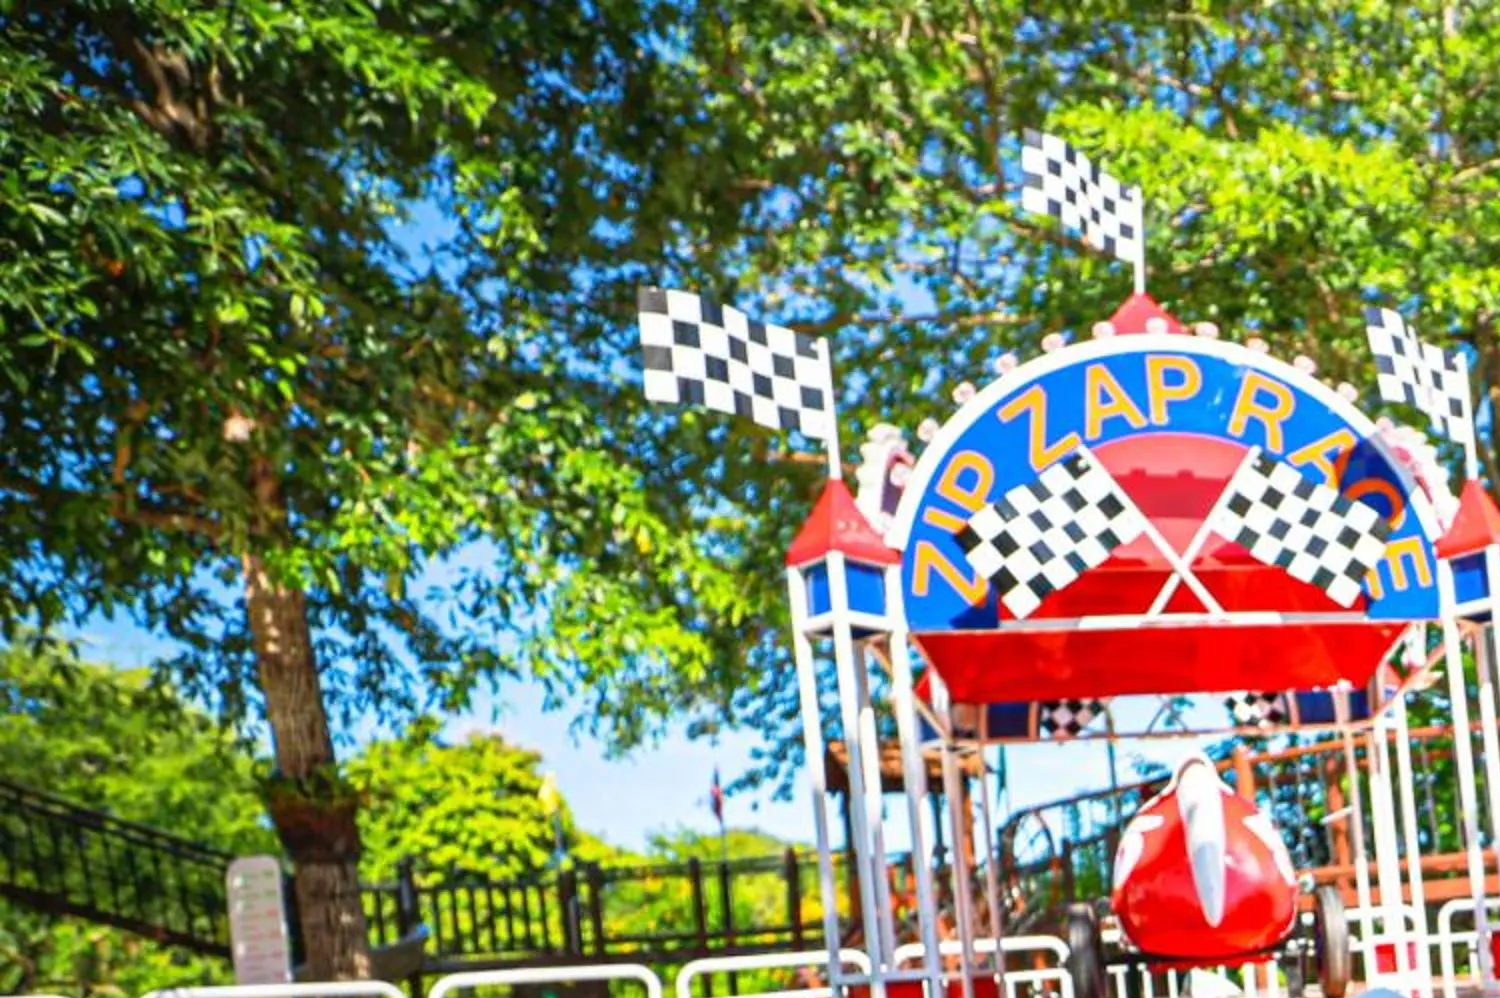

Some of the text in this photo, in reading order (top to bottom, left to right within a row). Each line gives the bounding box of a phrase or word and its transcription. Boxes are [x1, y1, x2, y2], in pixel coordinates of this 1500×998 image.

[912, 354, 1433, 608] ZIP ZAP RACE
